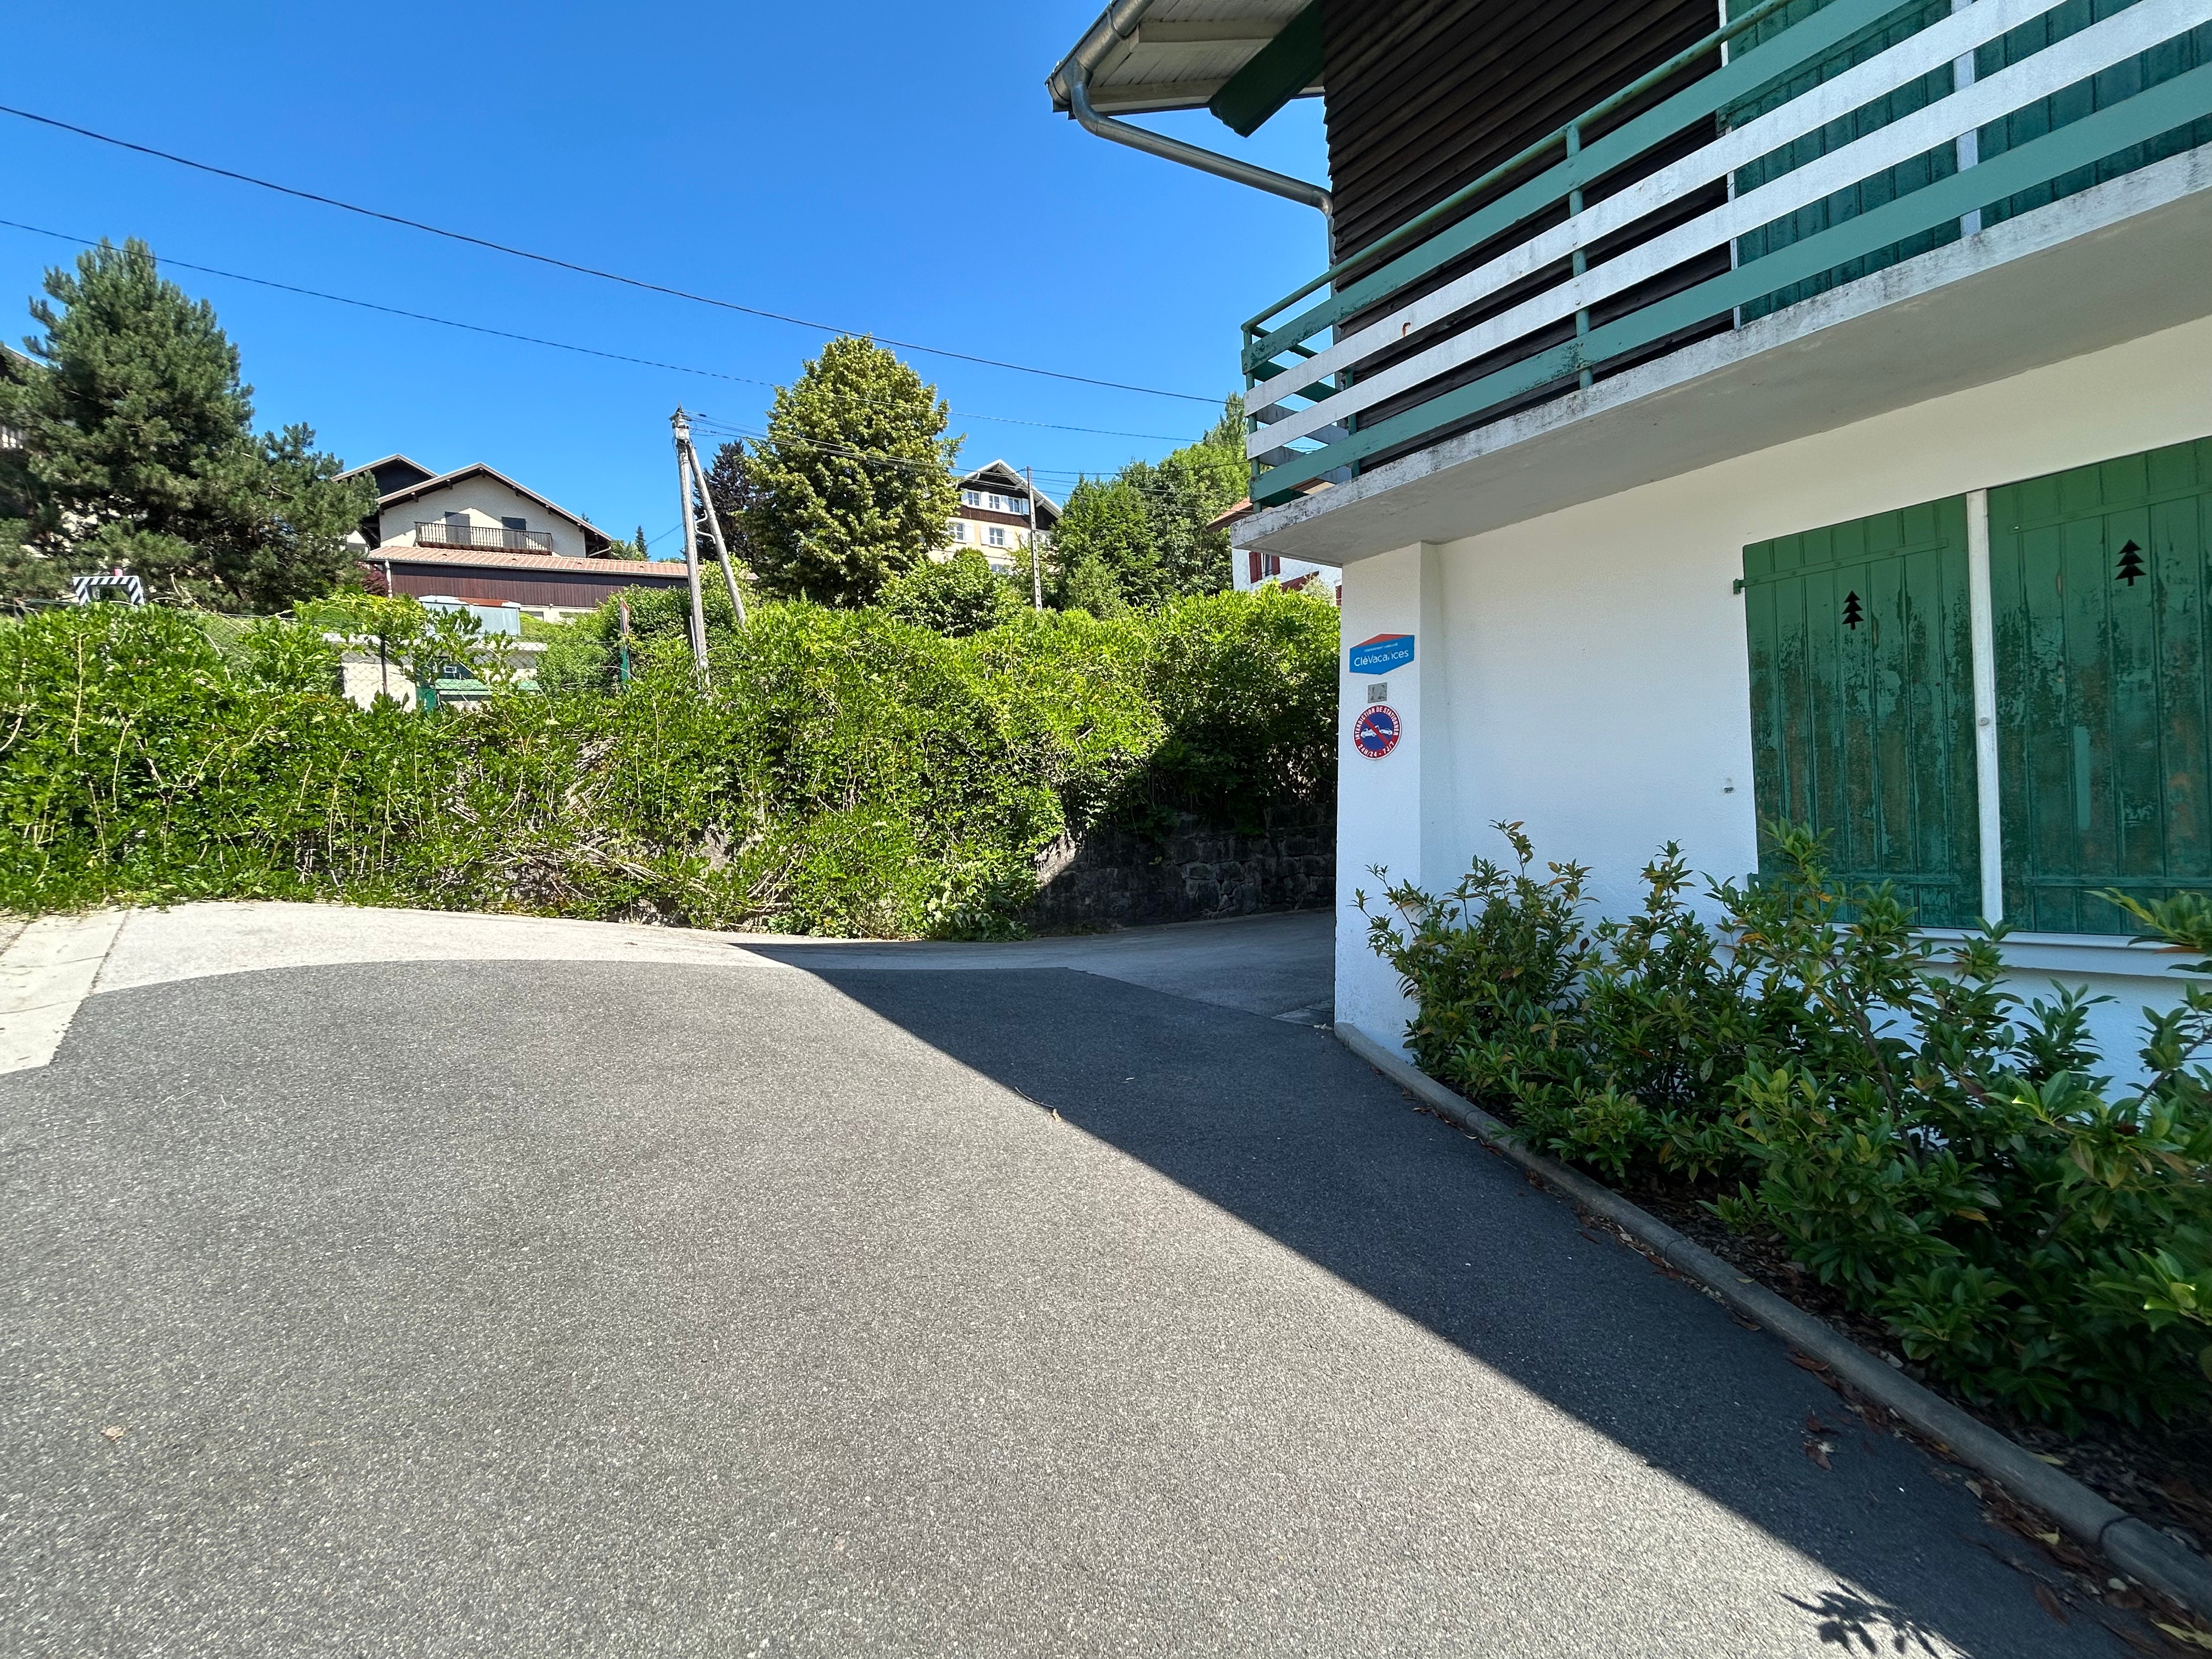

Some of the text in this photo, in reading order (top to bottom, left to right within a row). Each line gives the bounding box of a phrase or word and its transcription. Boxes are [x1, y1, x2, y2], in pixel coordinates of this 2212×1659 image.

[1355, 707, 1375, 740] INTERDICTION
[1383, 707, 1399, 736] STATIONNER
[1358, 744, 1378, 757] 24H/24
[1382, 741, 1395, 754] 7J/7
